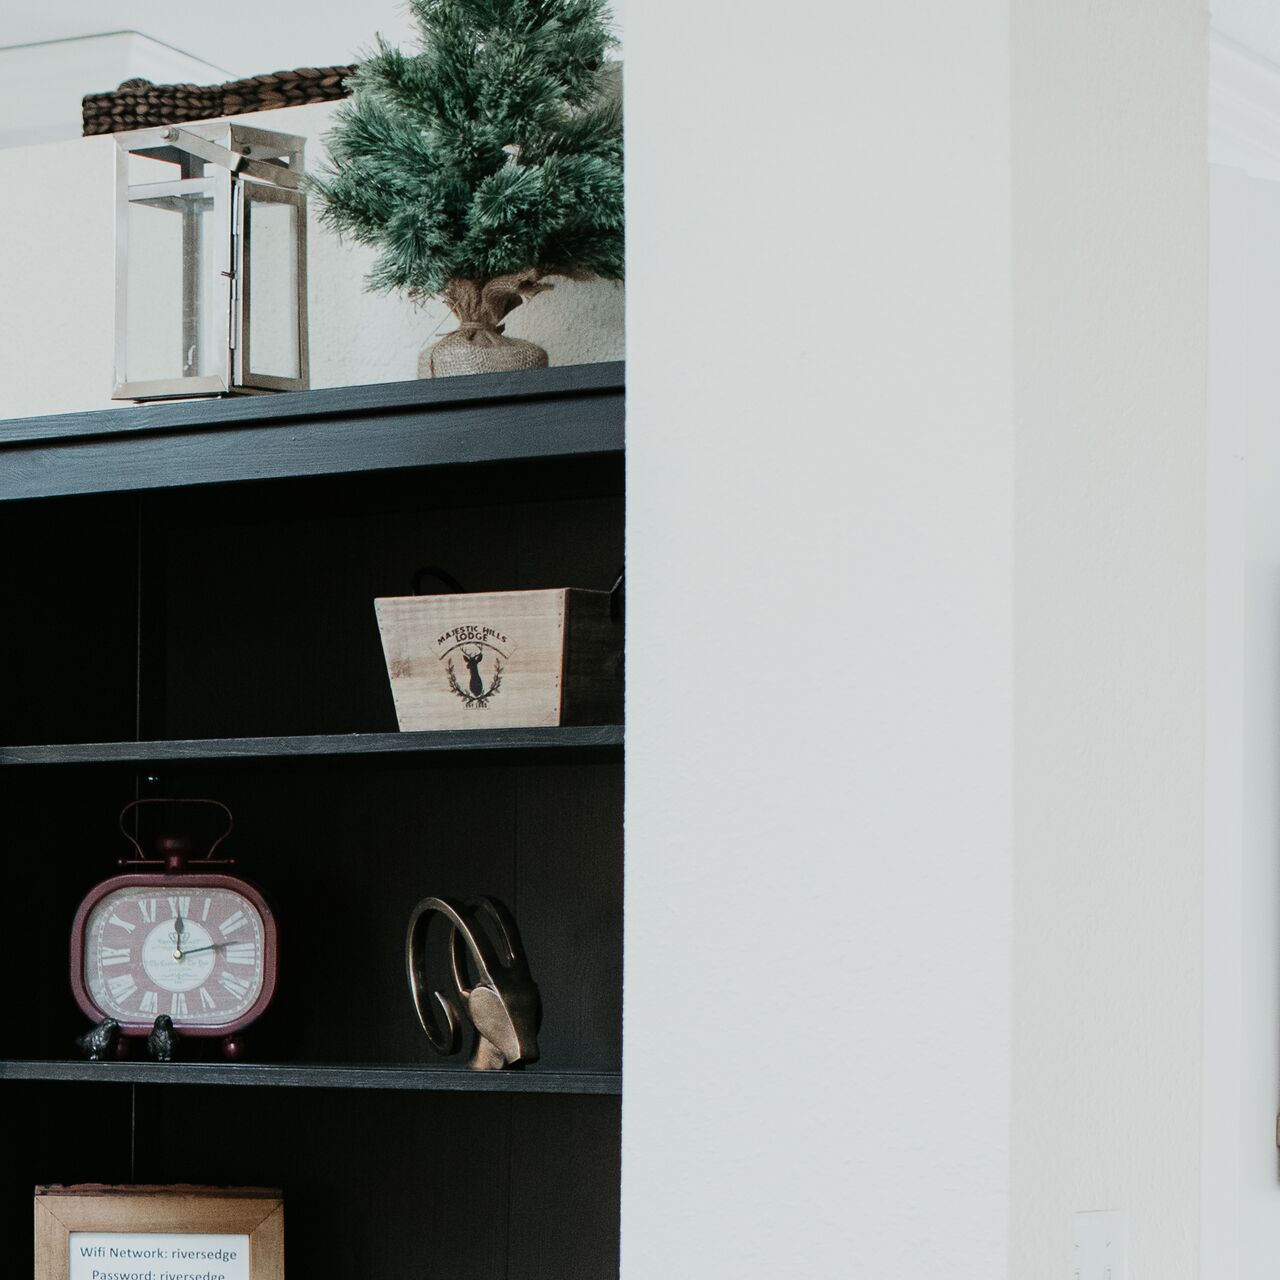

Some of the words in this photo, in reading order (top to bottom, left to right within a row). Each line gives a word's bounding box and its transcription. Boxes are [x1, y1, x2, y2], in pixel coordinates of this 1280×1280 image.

[437, 626, 478, 645] MAJESTIC
[482, 626, 507, 643] HILLS
[455, 632, 488, 642] LODGE
[80, 1247, 106, 1258] Wifi
[109, 1248, 168, 1259] Network:
[171, 1248, 237, 1262] riversedge
[92, 1270, 155, 1280] Password:
